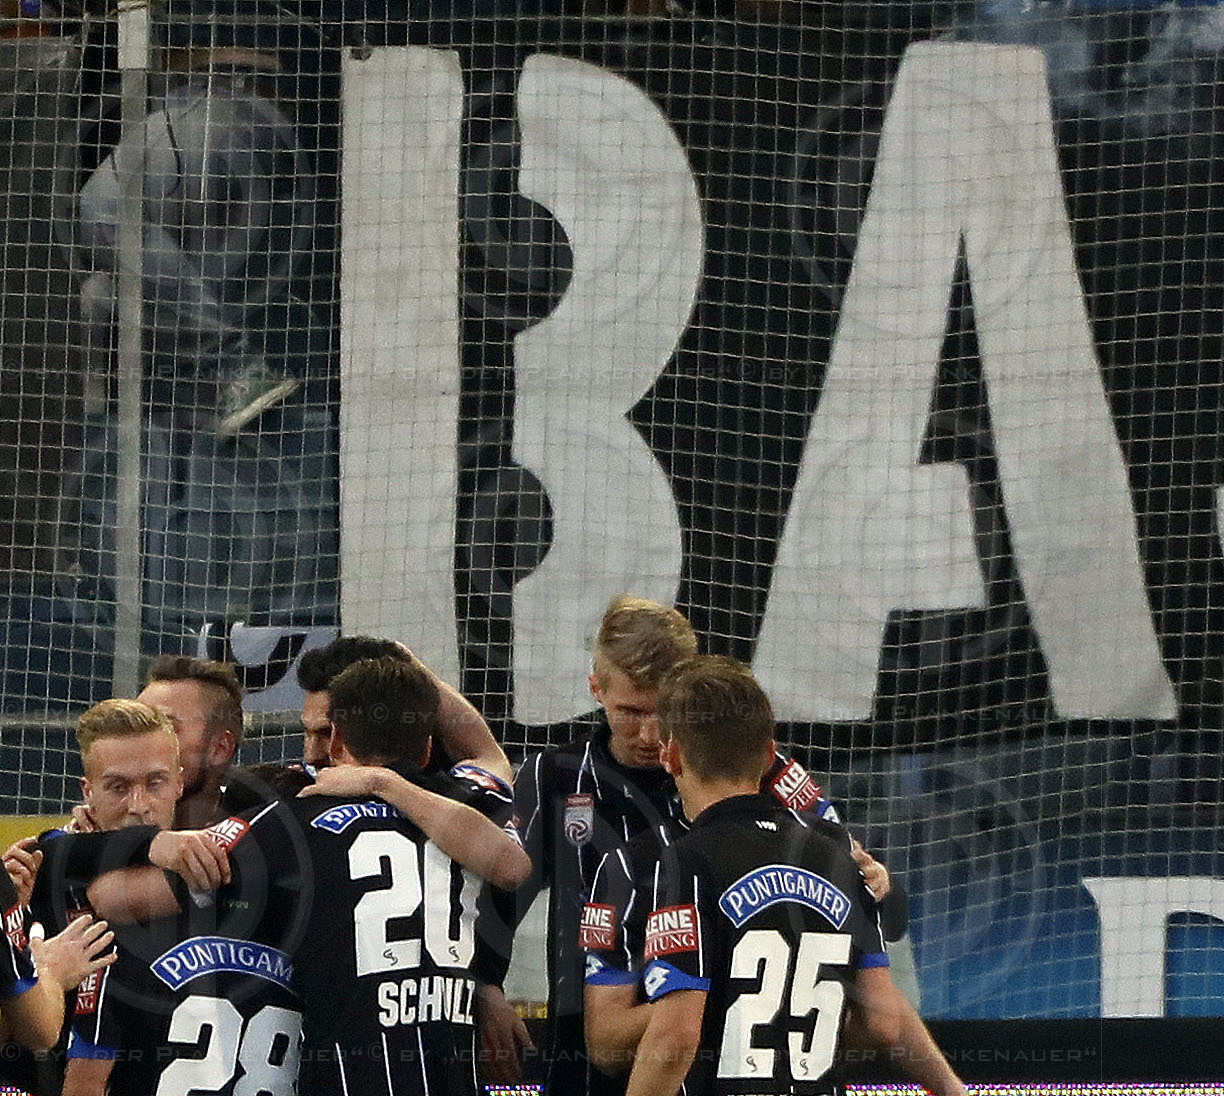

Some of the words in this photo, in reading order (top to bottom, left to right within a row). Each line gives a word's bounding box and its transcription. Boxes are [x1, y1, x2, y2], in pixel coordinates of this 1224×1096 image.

[341, 41, 1223, 724] BA
[348, 830, 485, 977] 20
[648, 909, 693, 933] EINE
[726, 872, 843, 921] PUNTIGAMER
[716, 929, 852, 1082] 25
